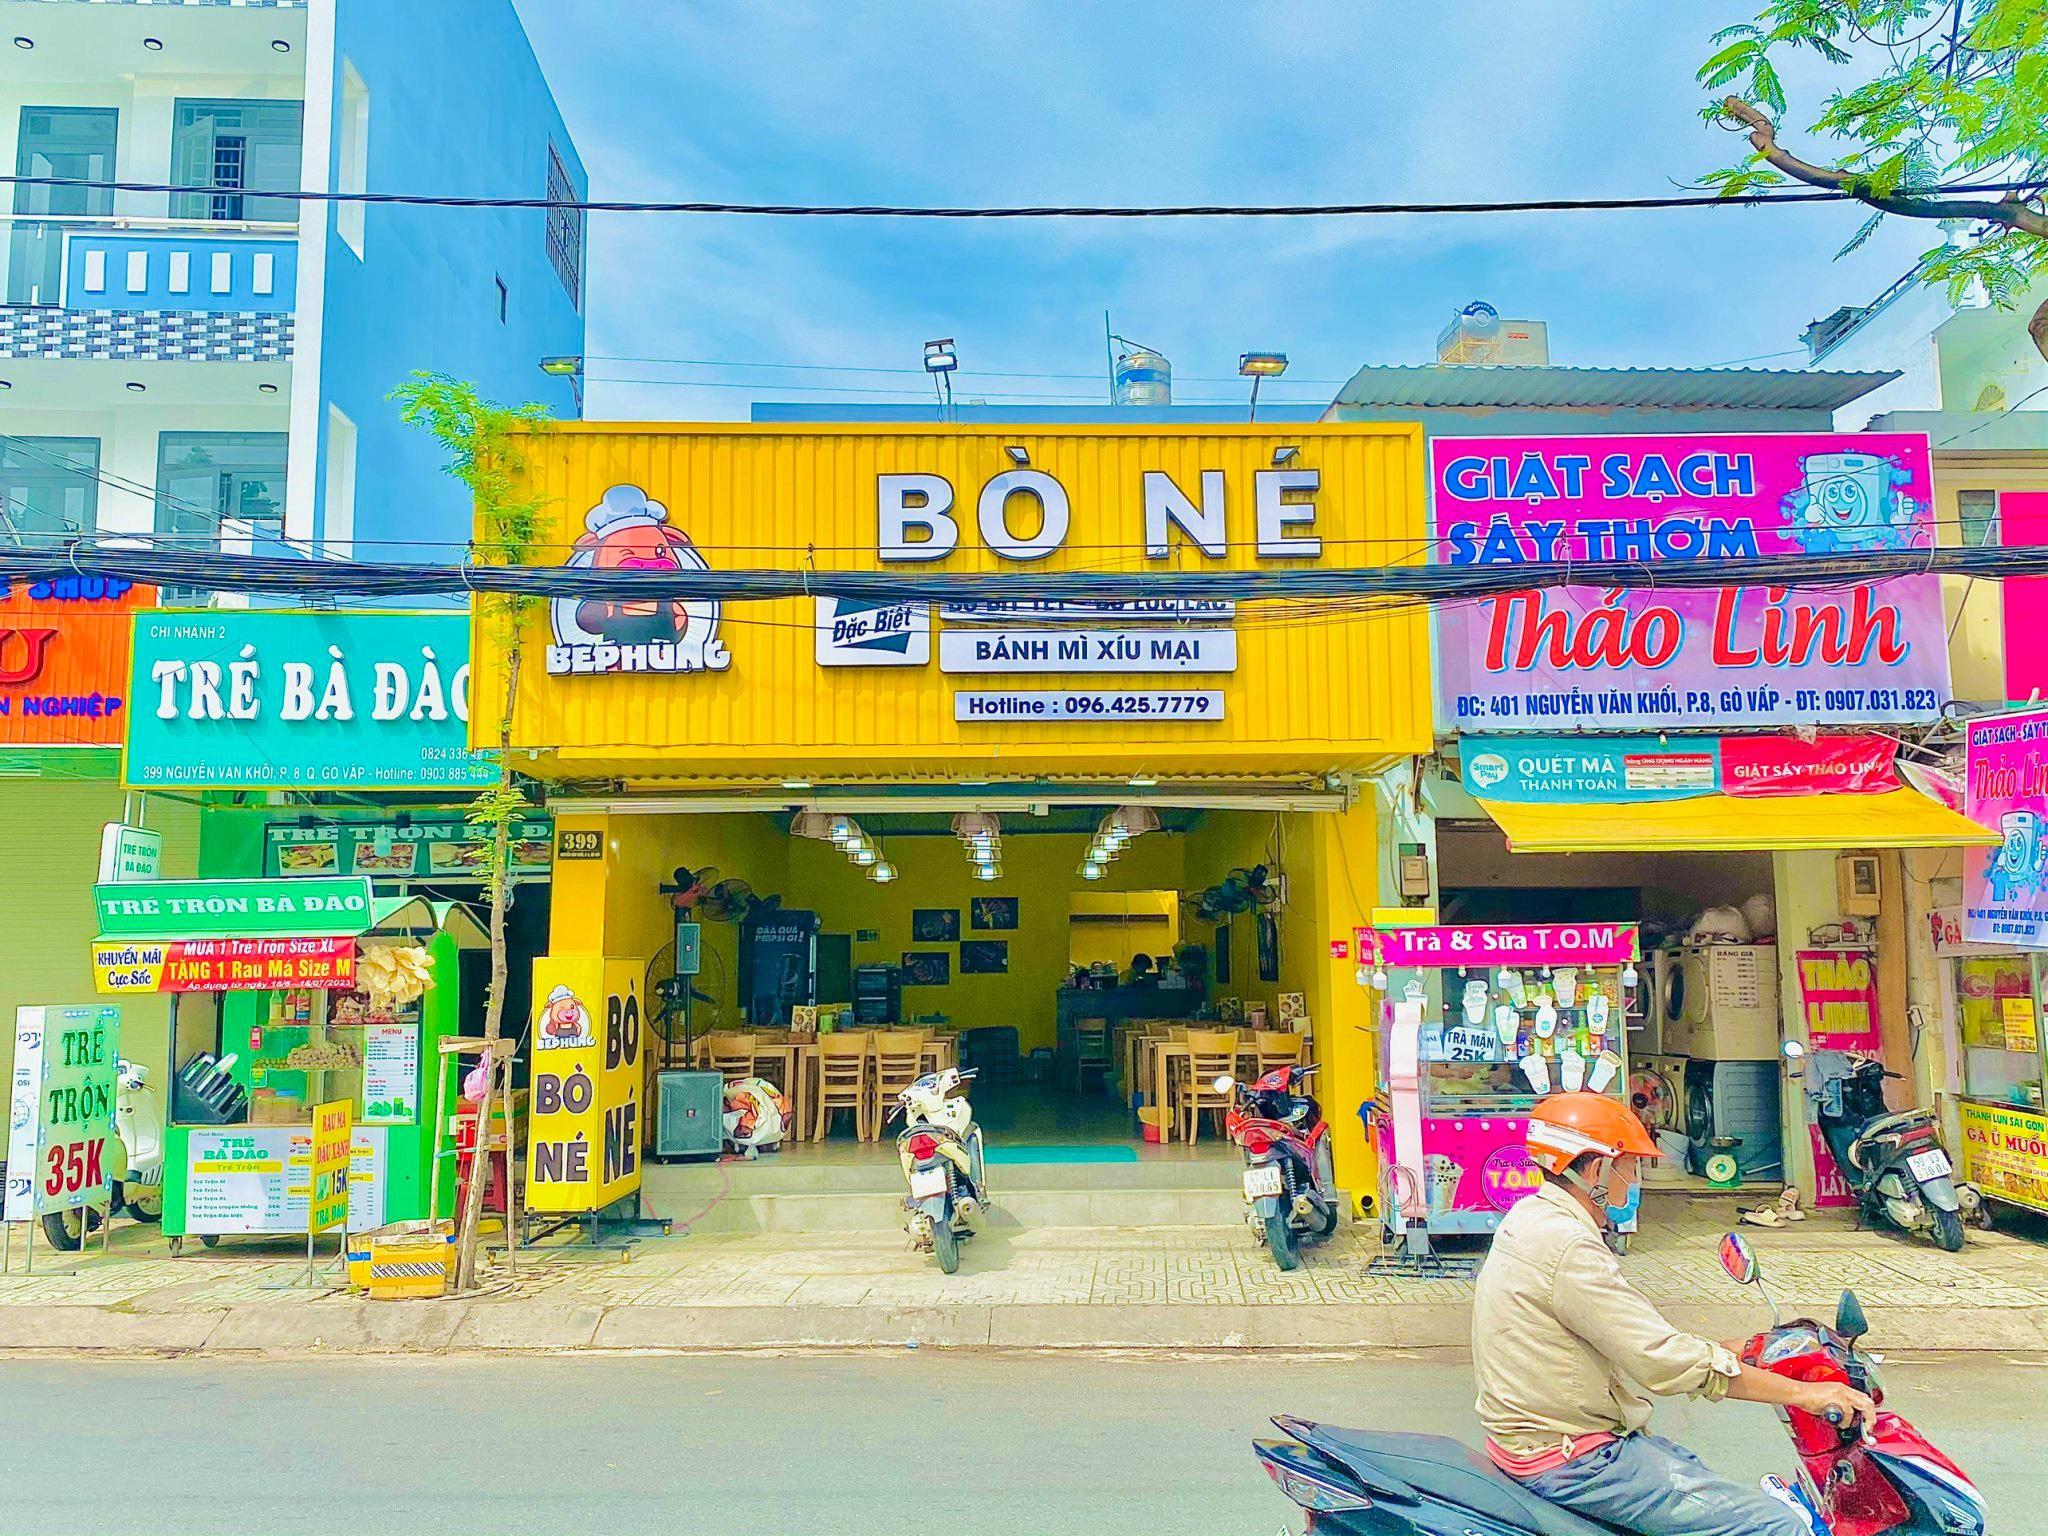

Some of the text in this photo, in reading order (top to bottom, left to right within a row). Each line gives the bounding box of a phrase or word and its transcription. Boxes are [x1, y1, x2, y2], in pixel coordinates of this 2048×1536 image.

[1443, 451, 1756, 505] GIẶT SẠCH
[876, 446, 1323, 562] BÒ NÉ
[1448, 512, 1760, 565] SẤY THƠM
[151, 624, 226, 639] CHI NHÁNH 2
[832, 606, 913, 643] Đặc Biệt
[1478, 584, 1910, 674] Thảo Linh
[975, 634, 1200, 666] BÁNH MÌ XÍU MẠI
[151, 643, 261, 720] TRÉ
[279, 644, 355, 721] BÀ
[22, 692, 123, 721] NGHIỆP
[969, 697, 1045, 715] Hotline
[1064, 697, 1210, 714] 096.425.7779
[1457, 695, 1486, 717] ĐC:
[1490, 695, 1519, 716] 401
[1526, 687, 1593, 716] NGUYỄN
[1597, 689, 1633, 714] VĂN
[1637, 685, 1682, 716] KHỐI,
[1686, 691, 1716, 715] P.8,
[1720, 686, 1743, 712] GÒ
[1747, 683, 1780, 712] VẤP
[1796, 690, 1821, 711] ĐT:
[1825, 688, 1936, 711] 0907.031.823
[421, 747, 447, 760] 0824
[449, 747, 468, 760] 336
[1518, 753, 1616, 777] QUÉT MÃ
[143, 765, 163, 780] 399
[166, 760, 215, 780] NGUYỄN
[218, 763, 242, 780] VĂN
[293, 766, 301, 780] 8
[321, 763, 340, 781] GÒ
[375, 767, 417, 781] Hotline:
[420, 767, 446, 781] 0903
[448, 767, 467, 781] 885
[1473, 762, 1504, 781] Smart Pay
[1518, 778, 1573, 791] THANH
[1575, 776, 1617, 791] TOÁN
[1734, 762, 1769, 781] GIẶT
[1772, 761, 1802, 777] SẤY
[1805, 762, 1847, 776] THẢO
[1974, 754, 2018, 801] Thảo
[564, 833, 599, 850] 399
[101, 892, 366, 918] TRÉ TRỘN BÀ ĐÀO
[183, 941, 215, 956] MUA
[219, 941, 227, 955] 1
[231, 940, 253, 955] Tré
[289, 938, 316, 954] Size
[318, 938, 336, 954] XL
[1399, 927, 1441, 952] Trà
[1449, 930, 1475, 952] &
[1482, 929, 1528, 952] Sữa
[1532, 927, 1614, 950] T.O.M
[97, 945, 162, 966] KHUYẾN MÃI
[168, 957, 351, 983] TẶNG 1 Rau Má Size M
[107, 968, 152, 989] Cực Sốc
[1803, 952, 1871, 992] THẢO
[605, 976, 640, 1071] BÒ
[1809, 1002, 1871, 1035] LINH
[62, 1019, 105, 1067] TRÉ
[1447, 1029, 1467, 1046] TRÀ
[1470, 1033, 1495, 1050] MẬN
[1450, 1047, 1487, 1061] 25K
[49, 1075, 111, 1130] TRỘN
[536, 1063, 593, 1114] BÒ
[603, 1084, 637, 1186] NÉ
[2004, 1132, 2048, 1158] MUỐI
[45, 1138, 106, 1197] 35K
[203, 1147, 270, 1160] BÀ ĐÀO
[534, 1130, 589, 1183] NÉ
[331, 1166, 349, 1196] 15K
